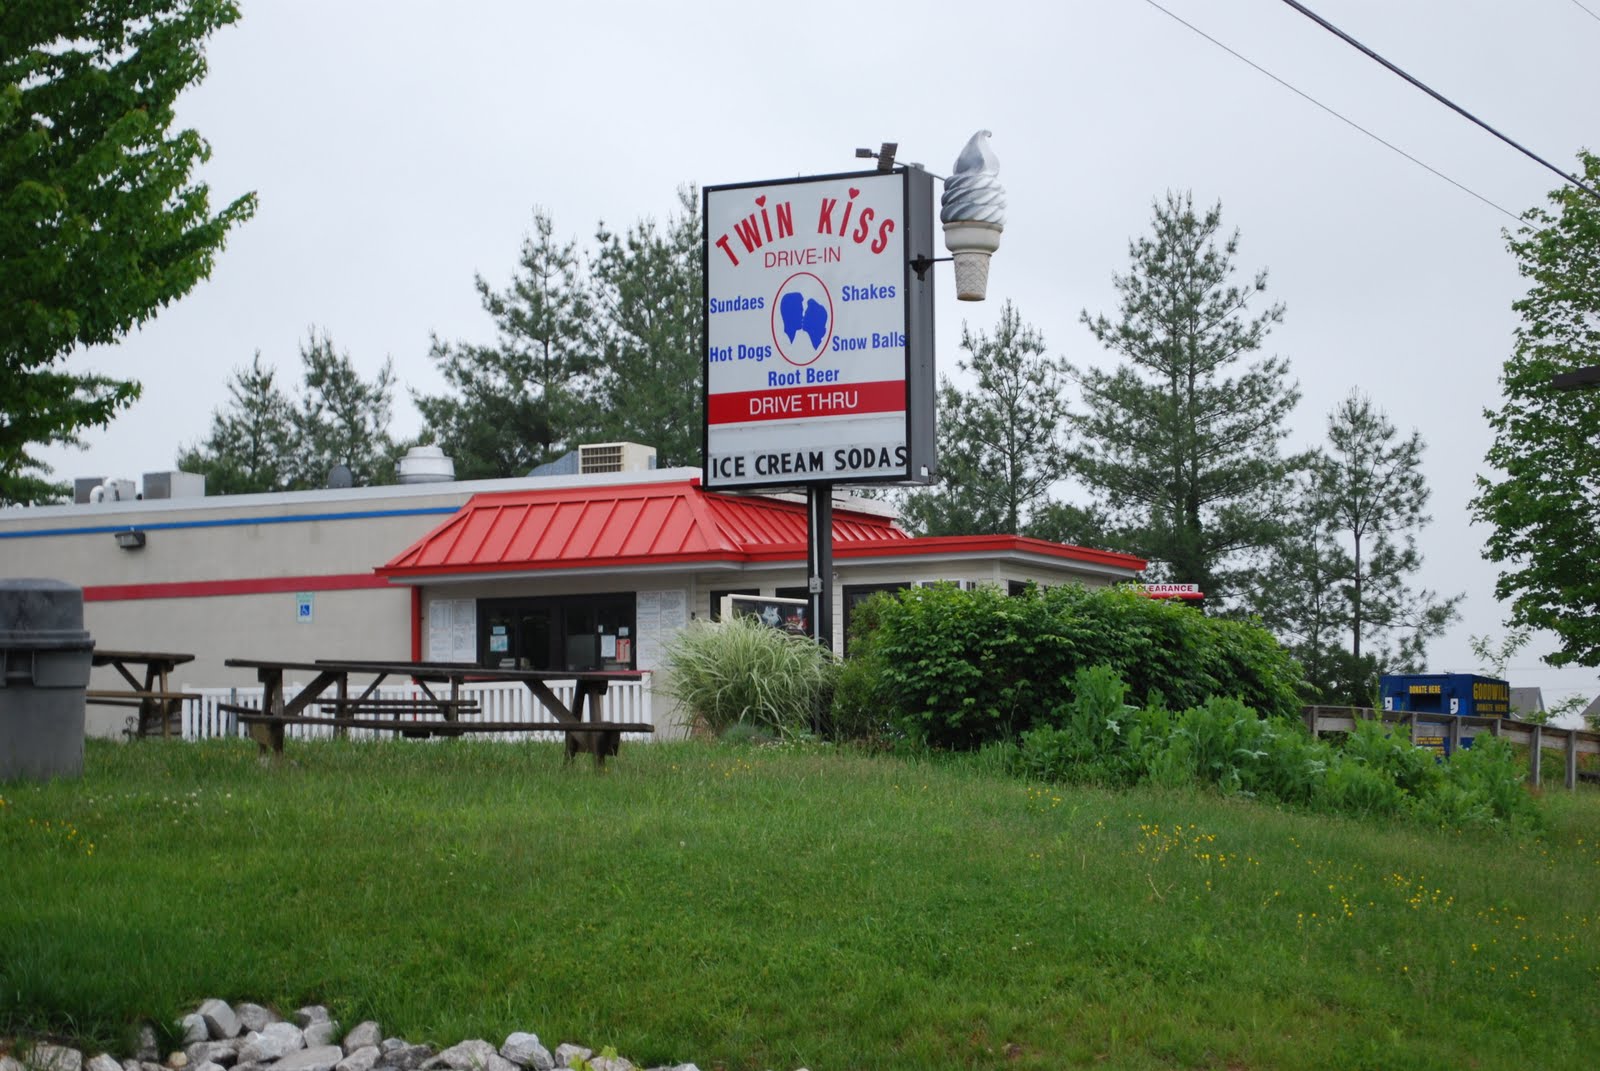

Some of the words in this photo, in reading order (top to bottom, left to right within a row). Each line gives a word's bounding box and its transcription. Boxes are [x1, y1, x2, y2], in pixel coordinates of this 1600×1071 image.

[764, 246, 841, 268] DRIVE-IN
[841, 283, 896, 302] Shakes
[710, 296, 765, 314] Sundaes
[832, 334, 867, 352] Snow
[872, 331, 906, 349] Balls
[709, 347, 733, 362] Hot
[737, 345, 772, 362] Dogs
[768, 369, 800, 387] Root
[806, 368, 840, 383] Beer
[749, 394, 802, 416] DRIVE
[807, 391, 858, 411] THRU
[712, 456, 745, 479] ICE
[754, 451, 824, 476] CREAM
[834, 446, 907, 471] SODAS
[1136, 584, 1193, 592] LEARANCE
[1473, 683, 1508, 701] GOODWILL
